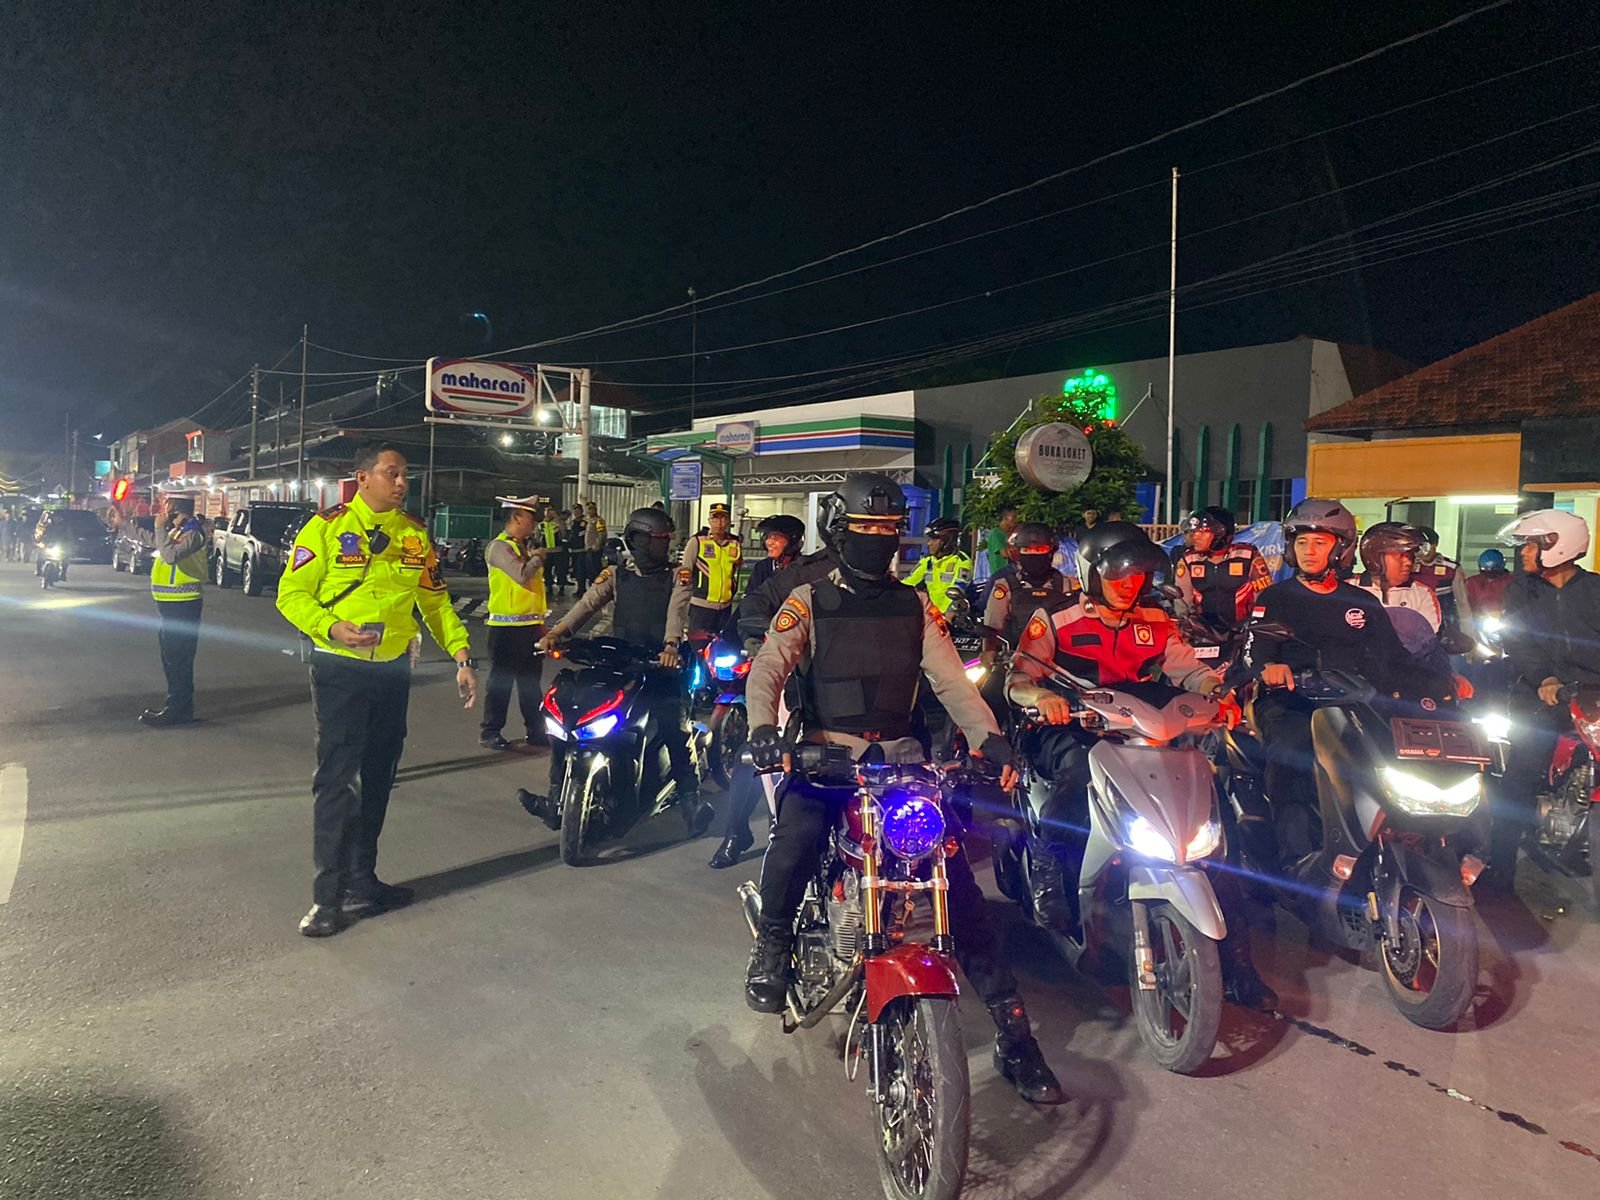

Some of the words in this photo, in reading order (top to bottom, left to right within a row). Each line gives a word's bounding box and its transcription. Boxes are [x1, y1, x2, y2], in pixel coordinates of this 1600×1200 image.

[441, 372, 526, 394] maharani
[720, 431, 751, 443] maharani
[1039, 444, 1061, 458] BUKA
[1062, 446, 1086, 460] LOKET
